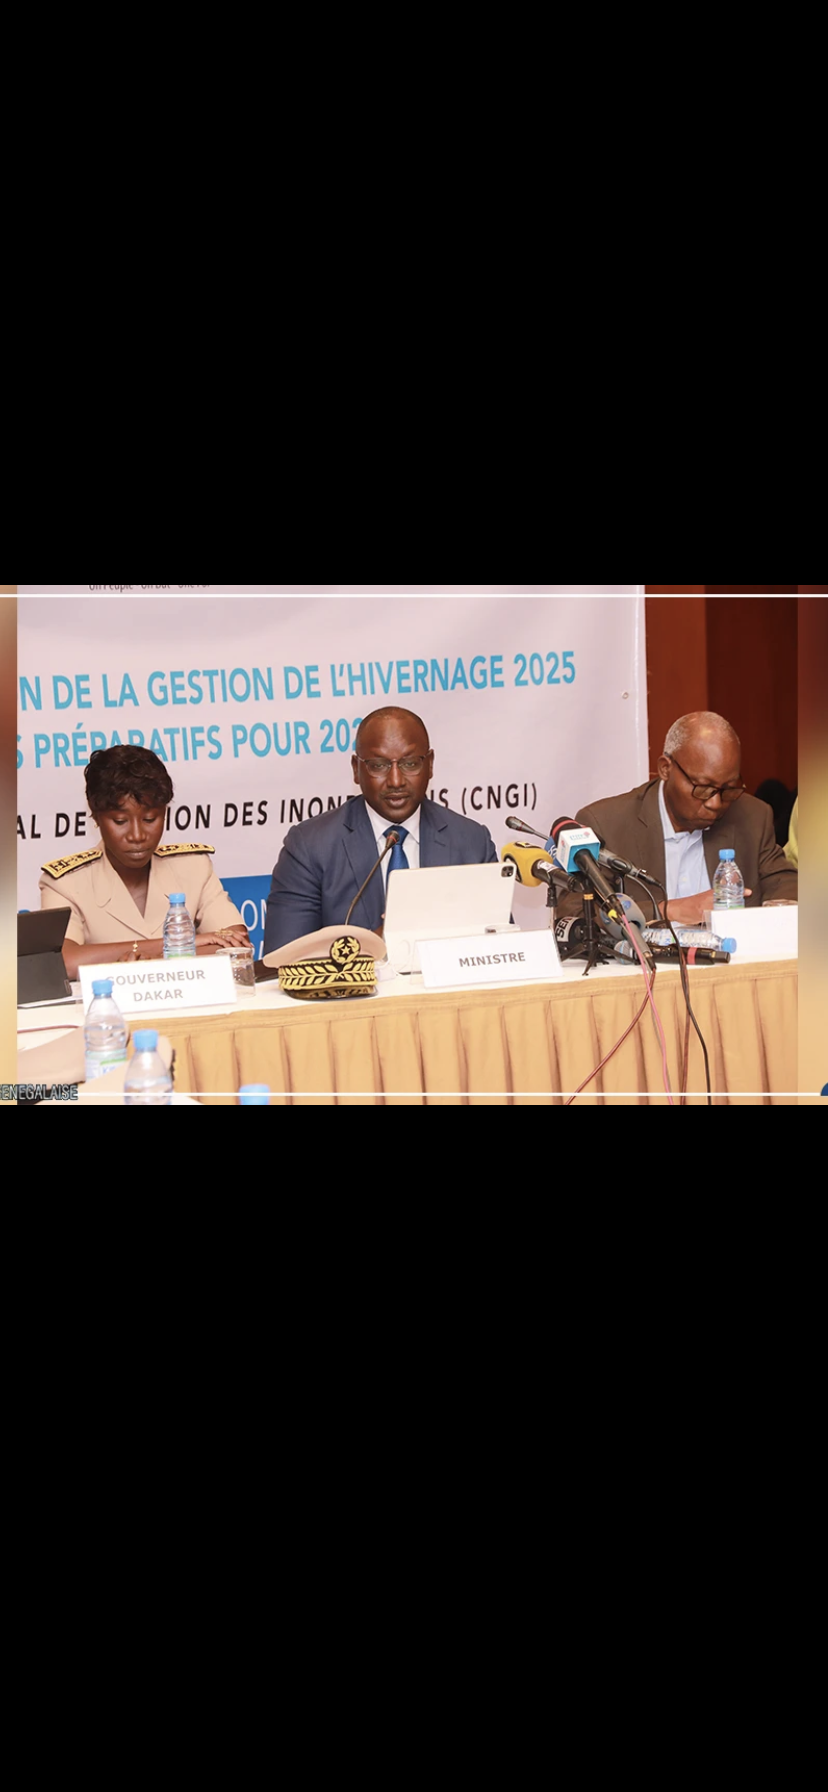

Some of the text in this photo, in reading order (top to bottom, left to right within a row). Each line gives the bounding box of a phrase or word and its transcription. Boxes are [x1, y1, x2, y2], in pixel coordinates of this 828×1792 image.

[52, 674, 93, 710] DE
[102, 673, 140, 708] LA
[147, 667, 274, 707] GESTION
[283, 665, 321, 700] DE
[330, 654, 505, 697] L'HIVERNAGE
[513, 650, 576, 687] 2025
[232, 721, 311, 758] POUR
[54, 811, 87, 838] DE
[223, 800, 268, 827] DES
[461, 782, 537, 816] (CNGI)
[458, 951, 526, 968] MINISTRE
[133, 988, 184, 1002] DAKAR
